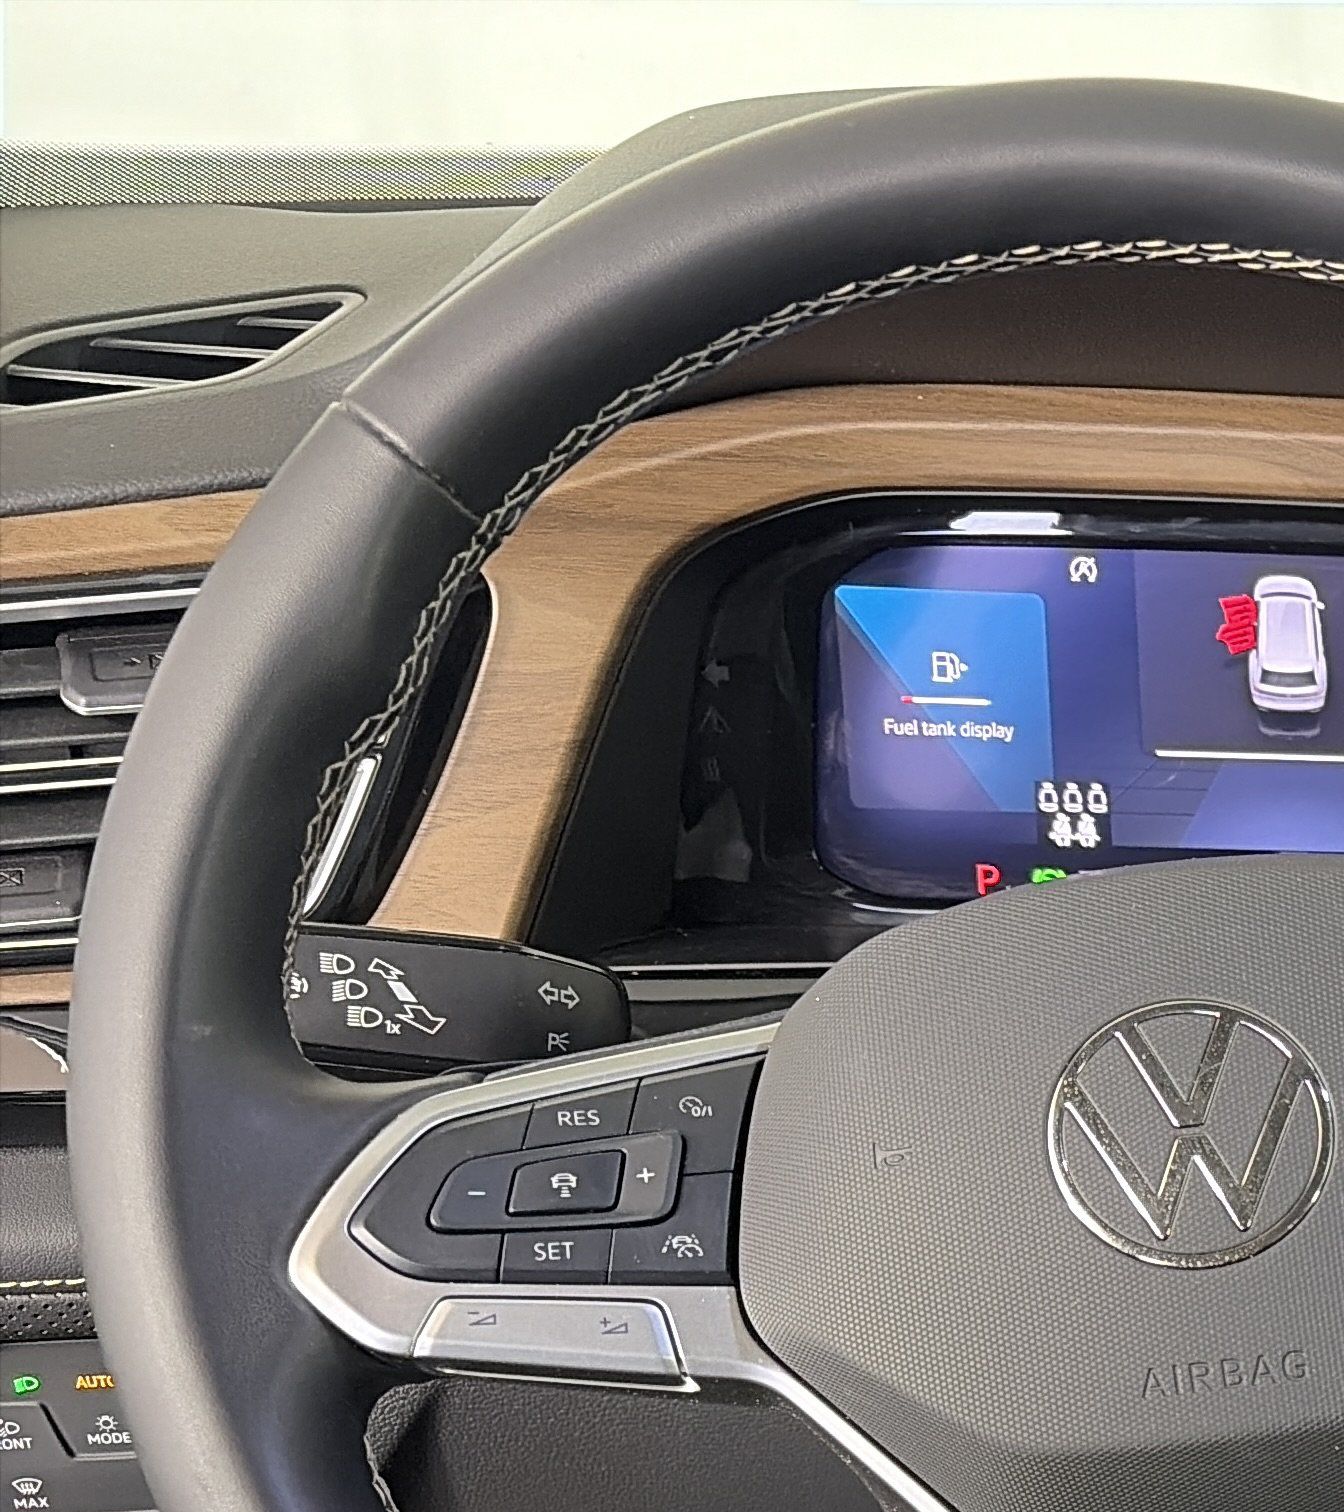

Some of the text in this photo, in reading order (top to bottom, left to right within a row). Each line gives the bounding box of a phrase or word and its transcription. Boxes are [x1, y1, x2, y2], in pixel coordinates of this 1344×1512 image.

[883, 718, 1014, 742] Fuel tank display
[975, 863, 1001, 896] P
[557, 1110, 600, 1127] RES
[534, 1242, 574, 1261] SET
[1141, 1349, 1306, 1399] AIRBAG
[87, 1431, 133, 1446] MODE
[13, 1496, 50, 1510] MAX
